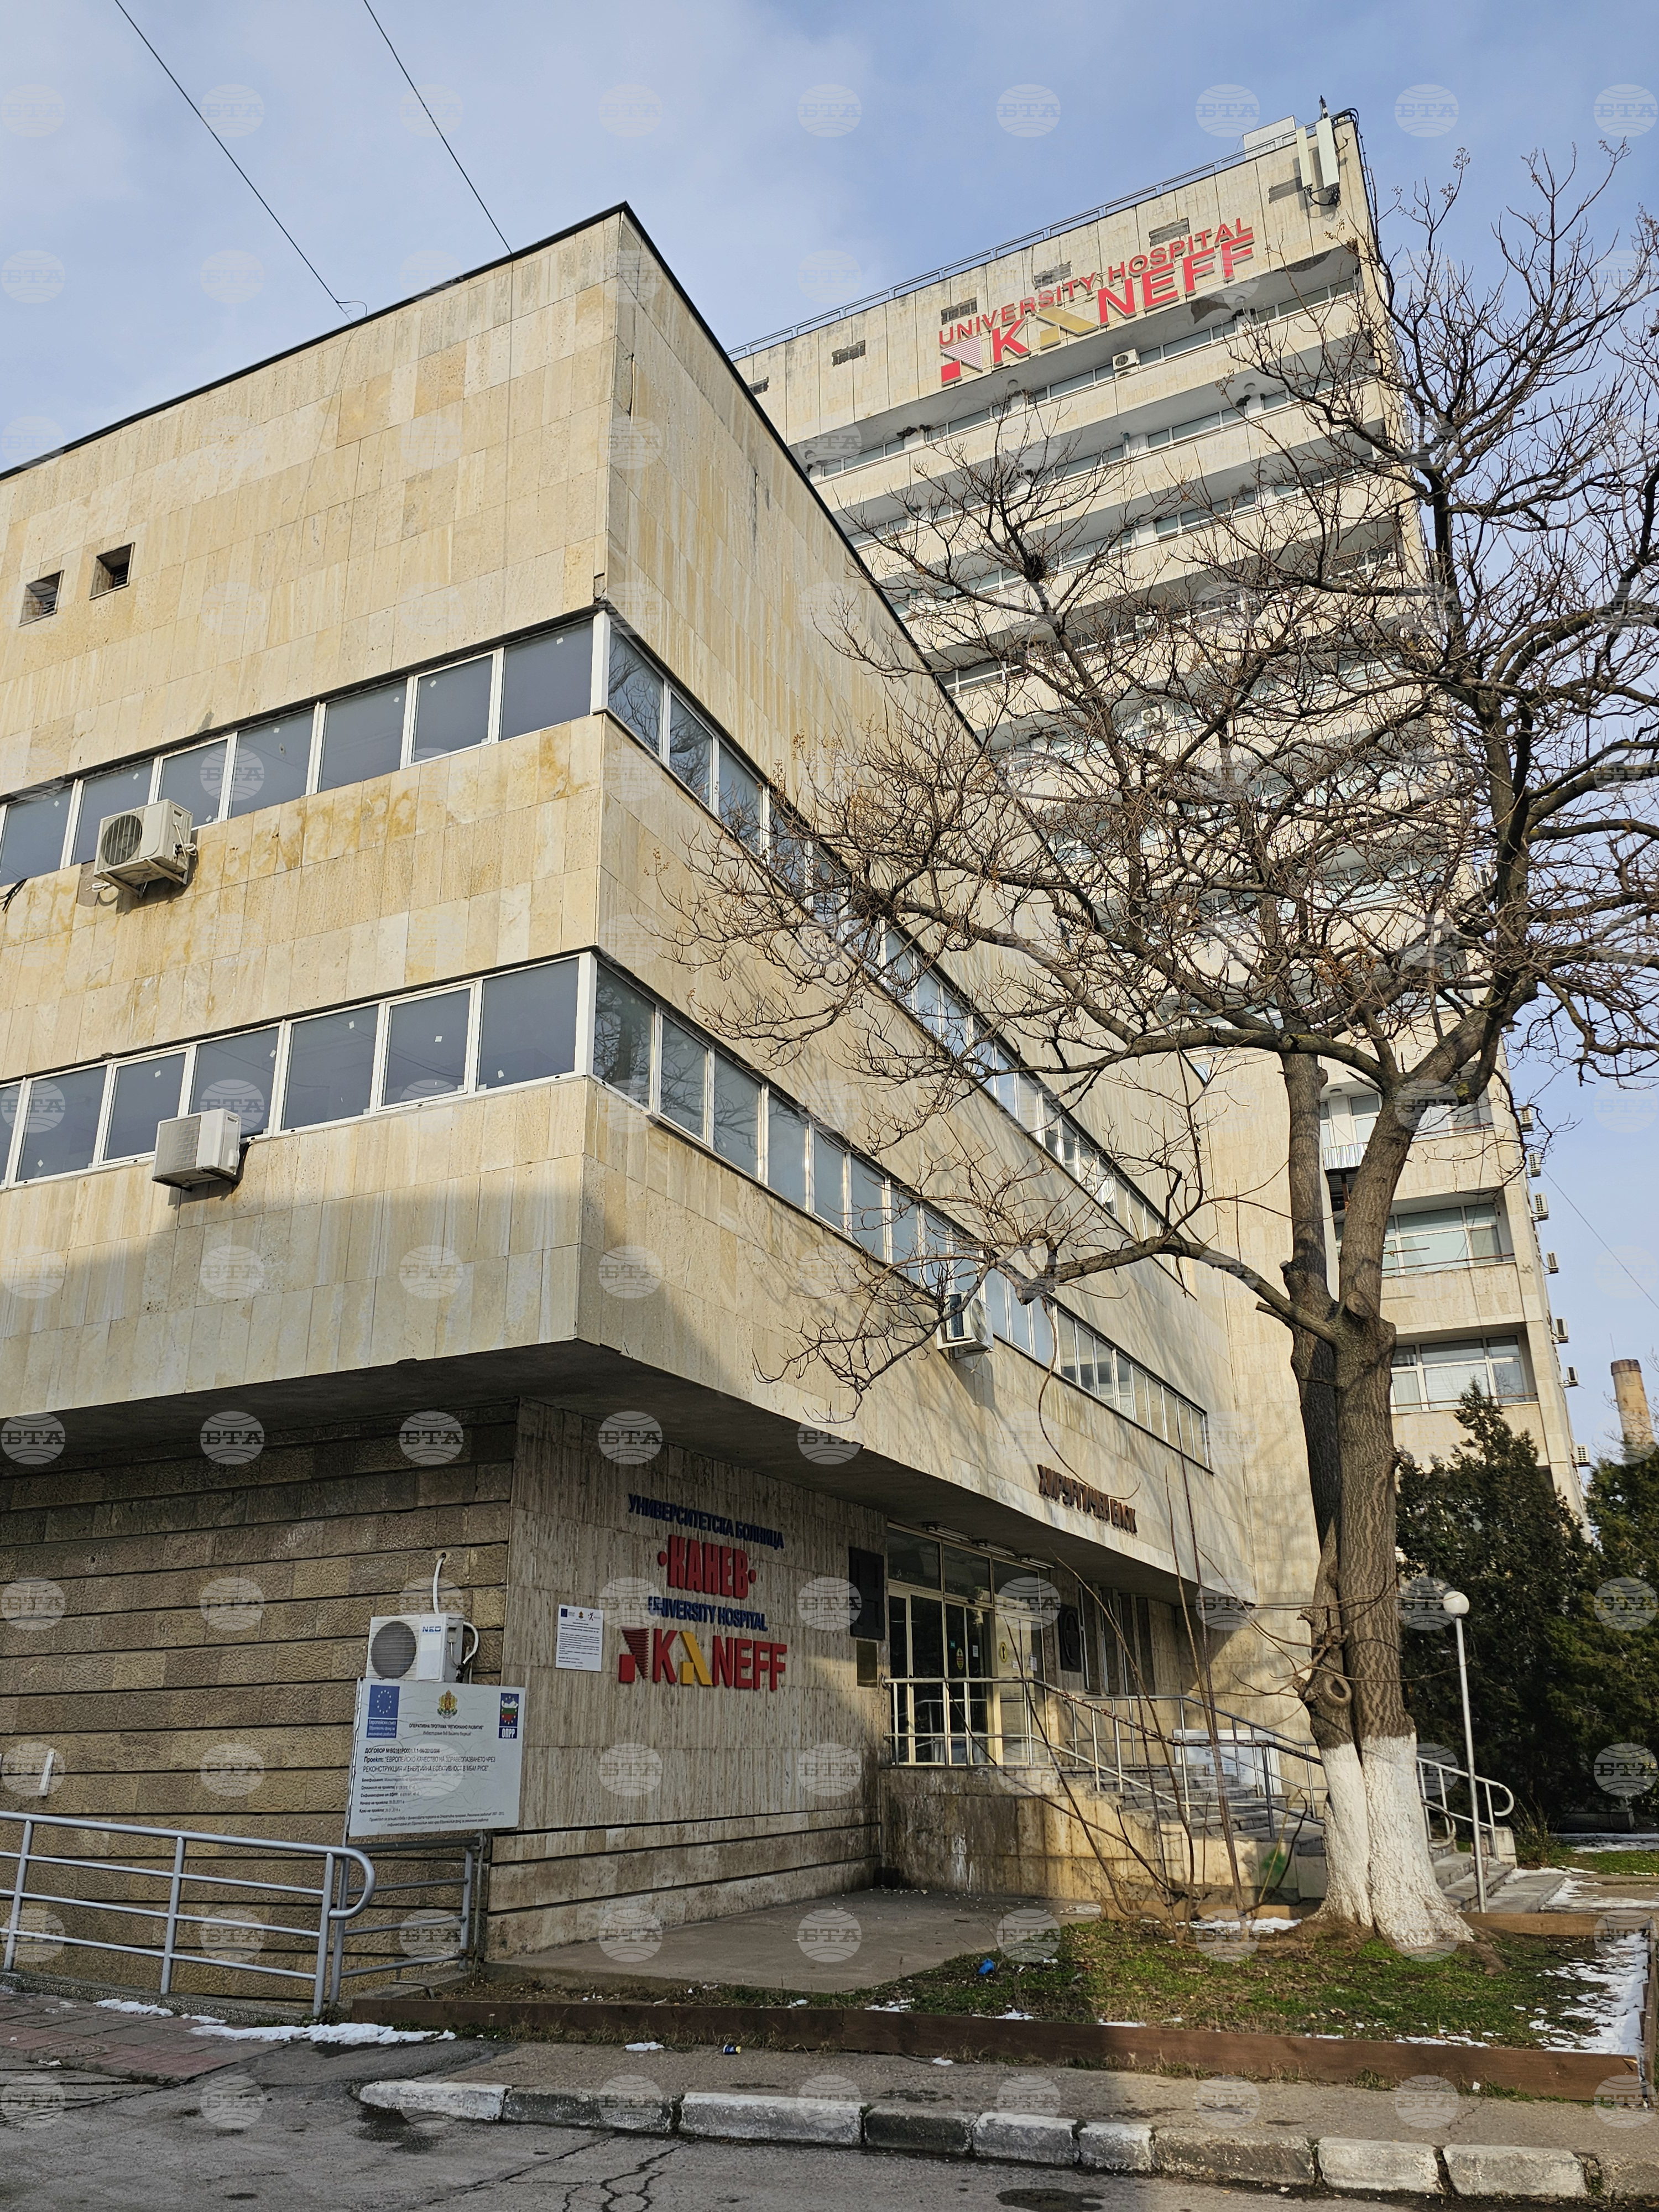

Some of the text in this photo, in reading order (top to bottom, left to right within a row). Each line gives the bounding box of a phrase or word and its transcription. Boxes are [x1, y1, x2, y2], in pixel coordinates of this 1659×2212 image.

[939, 218, 1254, 347] UNIVERSITY HOSPITAL
[628, 1494, 784, 1550] УНИВЕРСИТЕТСКА БОЛНИЦА
[648, 1595, 768, 1631] UNIVERSITY HOSPITAL
[502, 1728, 515, 1739] ОПРР
